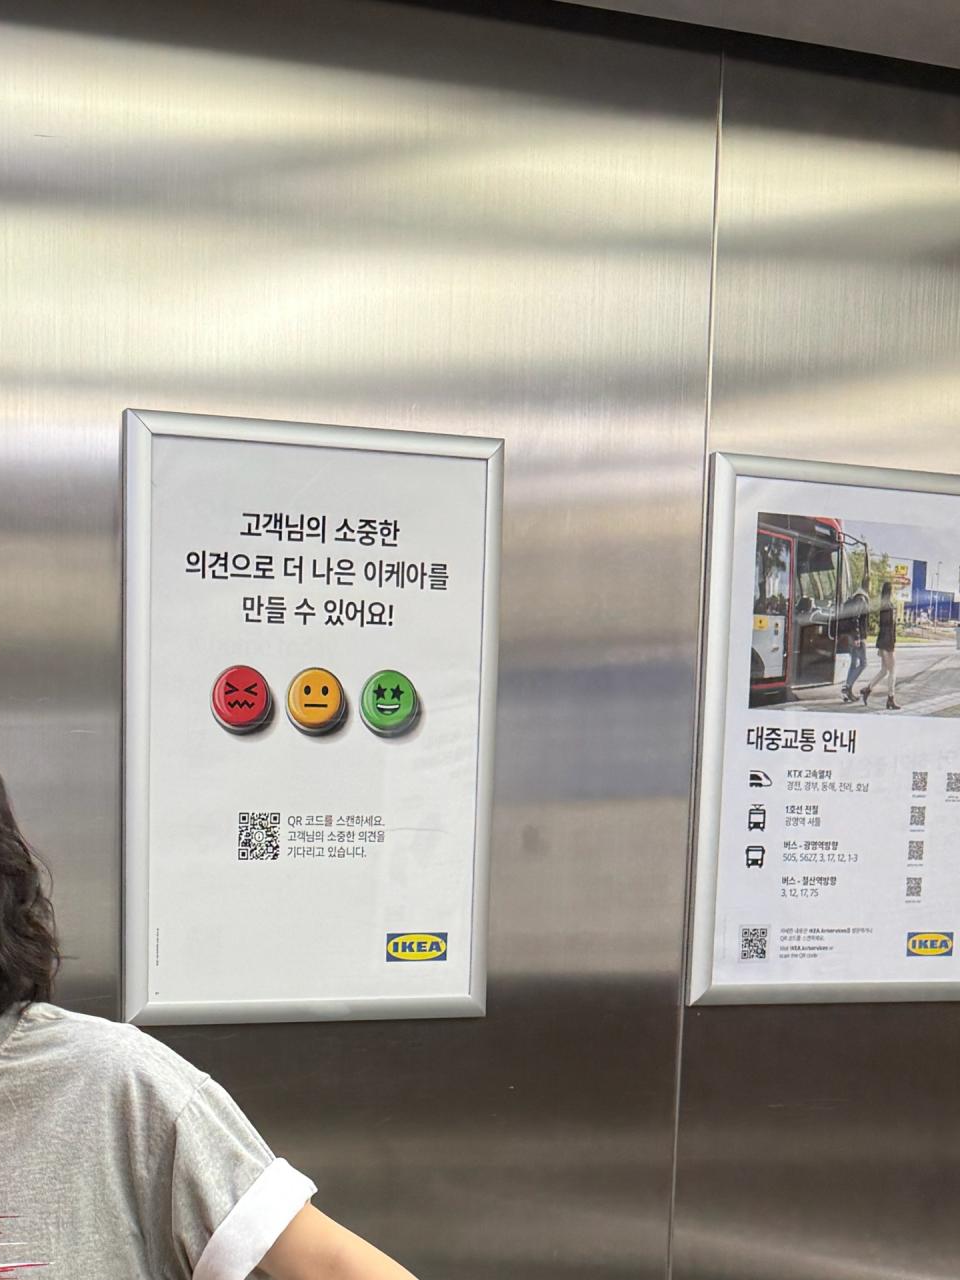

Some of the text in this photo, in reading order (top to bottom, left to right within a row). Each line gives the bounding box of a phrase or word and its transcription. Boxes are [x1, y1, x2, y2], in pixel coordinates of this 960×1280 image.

[240, 512, 400, 547] 고객님의 소중한
[185, 550, 449, 590] 의견으로 더 나은 이케아를
[242, 595, 394, 627] 만들 수 있어요!
[746, 726, 856, 754] 대중교통 안내
[787, 769, 803, 778] KTX
[287, 815, 385, 827] QR 코드를 스캔하세요.
[287, 830, 385, 843] 고객님의 소중한 의견을
[783, 841, 798, 850] 버스
[287, 846, 367, 858] 기다리고 있습니다.
[781, 876, 796, 885] 버스
